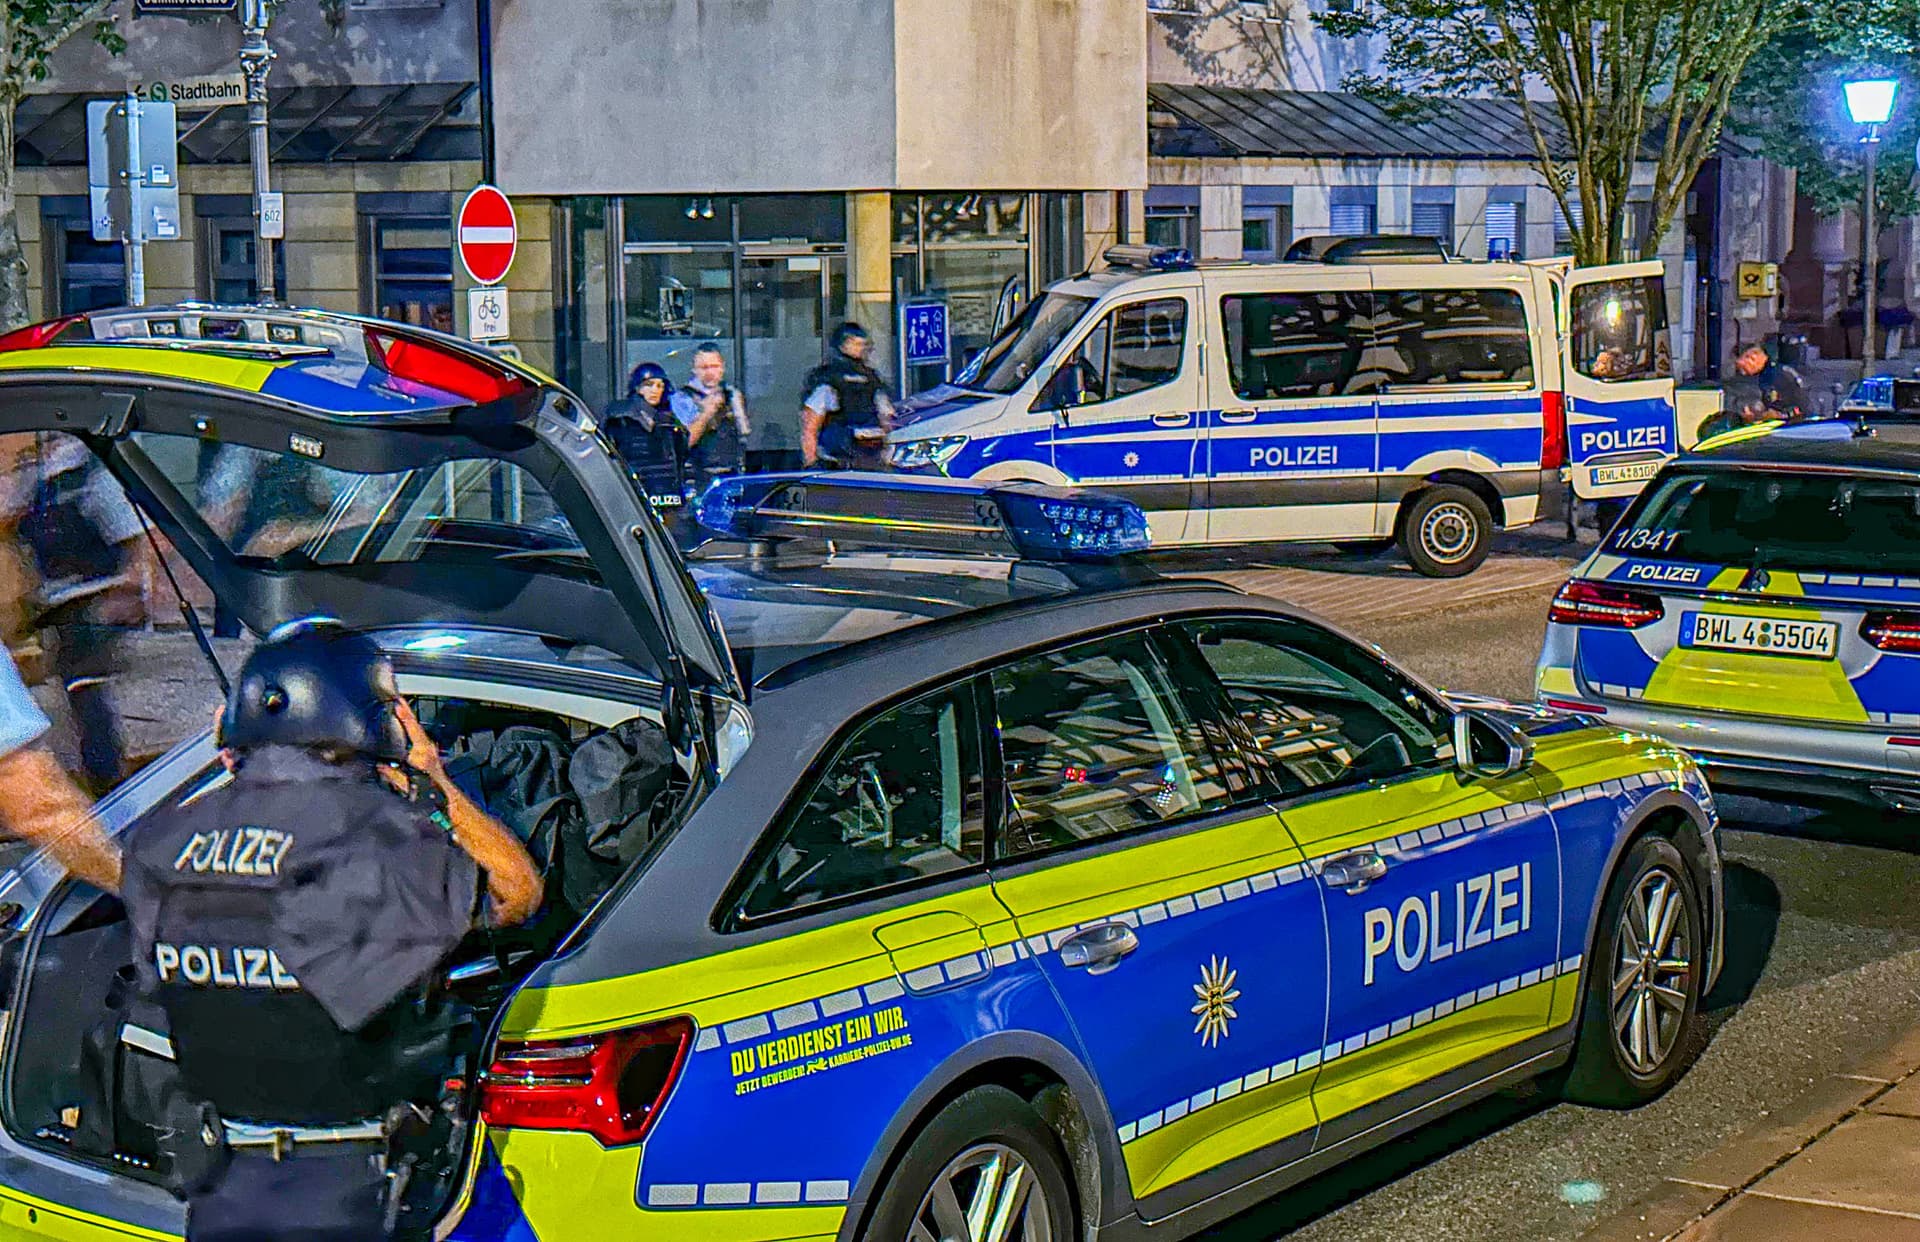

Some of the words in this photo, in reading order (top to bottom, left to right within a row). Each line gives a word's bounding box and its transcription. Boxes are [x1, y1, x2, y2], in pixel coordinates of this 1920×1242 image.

[171, 81, 241, 100] Stadtbahn
[264, 209, 281, 222] 602
[1581, 425, 1666, 452] POLIZEI
[1250, 446, 1338, 467] POLIZEI
[1599, 469, 1618, 481] BWL
[650, 495, 682, 505] OLIZEI
[1615, 528, 1680, 552] 1/341
[1627, 565, 1700, 583] POLIZEI
[1696, 617, 1736, 644] BWL
[1743, 621, 1755, 646] 4
[1773, 624, 1828, 652] 5504
[1364, 861, 1531, 987] POLIZEI
[155, 942, 300, 988] POLIZE
[731, 1047, 755, 1077] DU
[756, 1023, 843, 1069] VERDIENST
[845, 1015, 872, 1044] EIN
[873, 1006, 909, 1036] WIR.
[735, 1077, 760, 1096] JETZT
